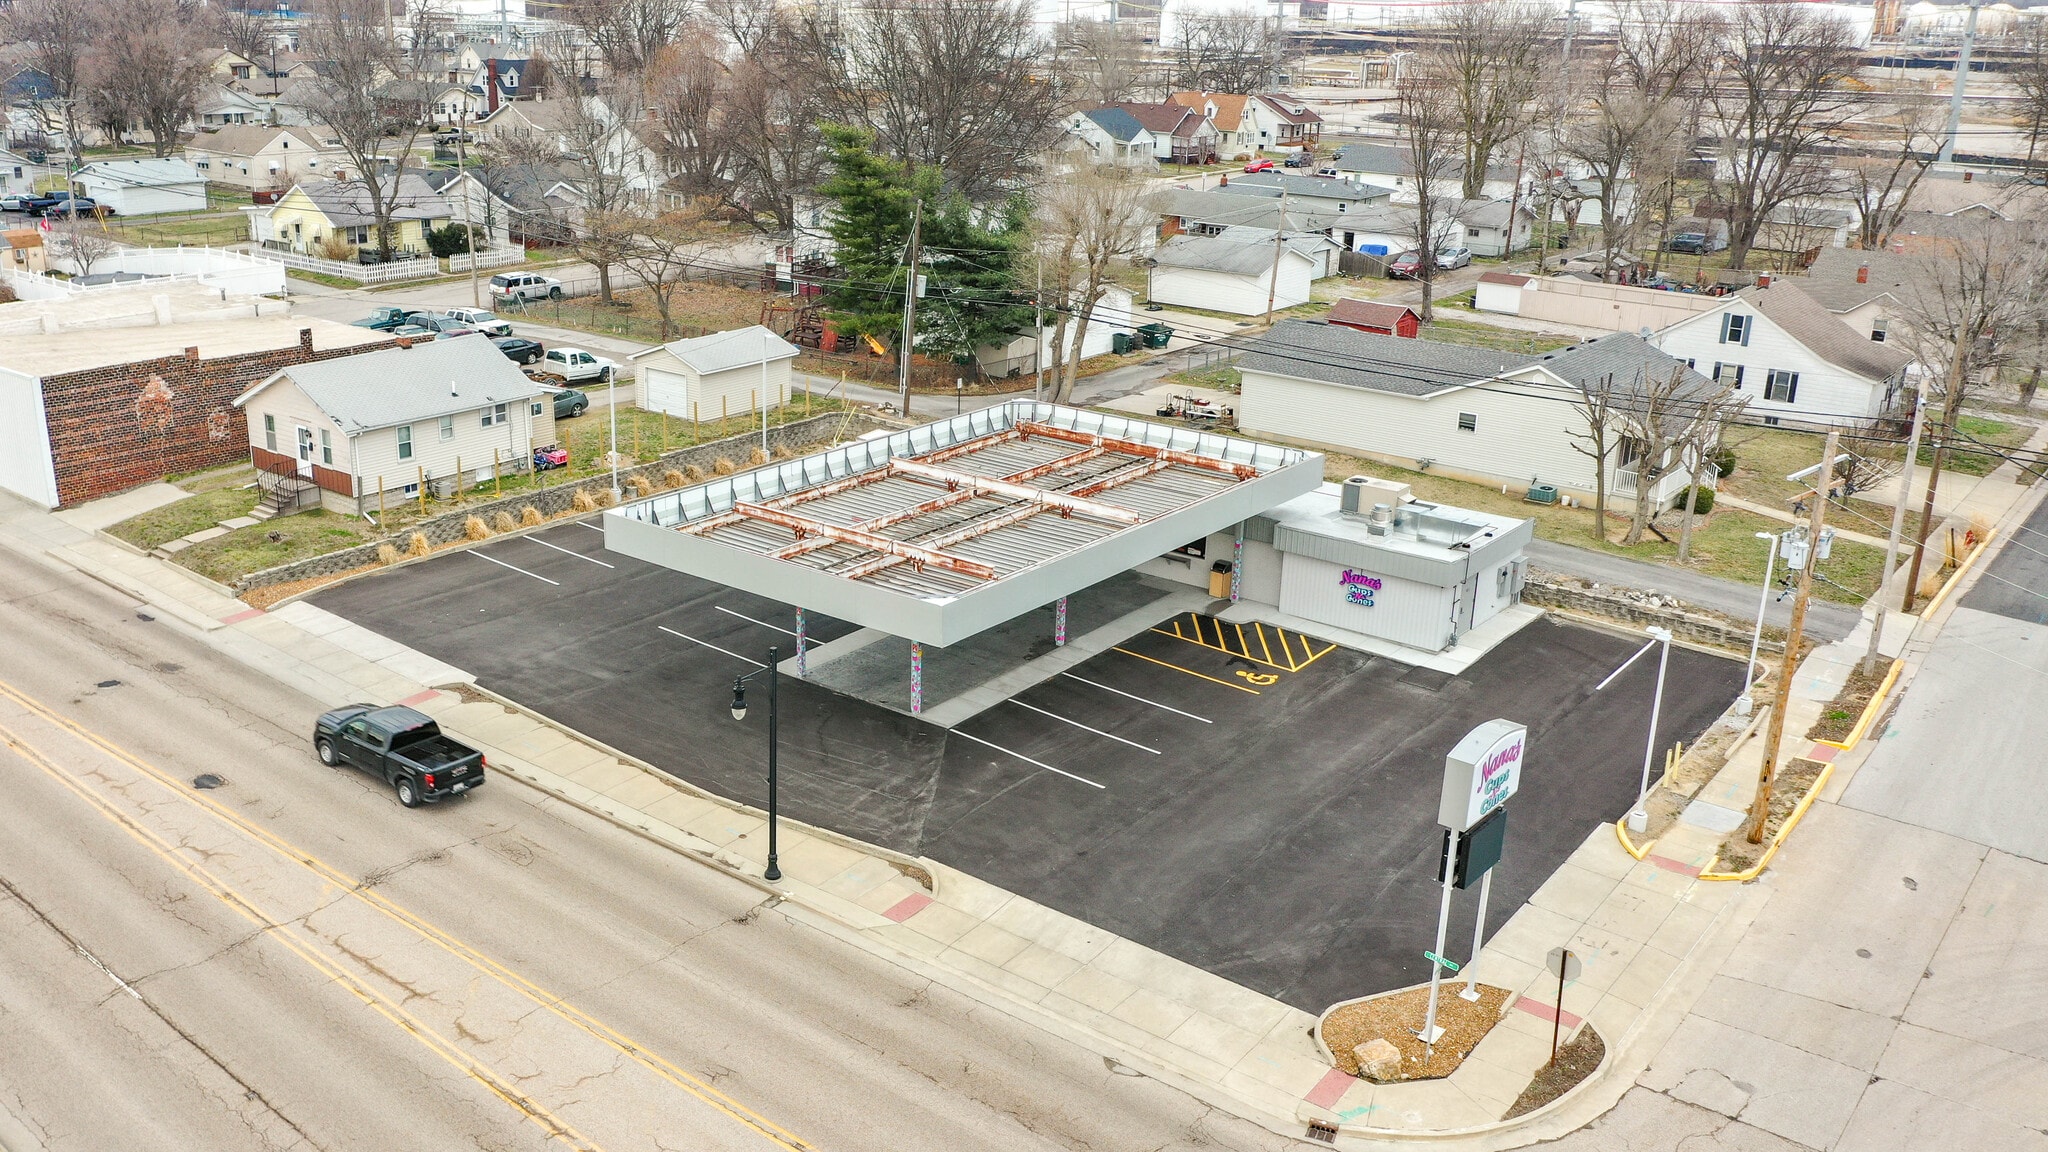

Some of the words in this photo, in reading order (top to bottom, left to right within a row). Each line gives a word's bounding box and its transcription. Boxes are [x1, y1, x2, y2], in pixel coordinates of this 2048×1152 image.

[1345, 593, 1375, 607] Cones
[1348, 584, 1374, 597] Cups
[1484, 769, 1510, 795] Cups
[1480, 786, 1509, 815] Cones
